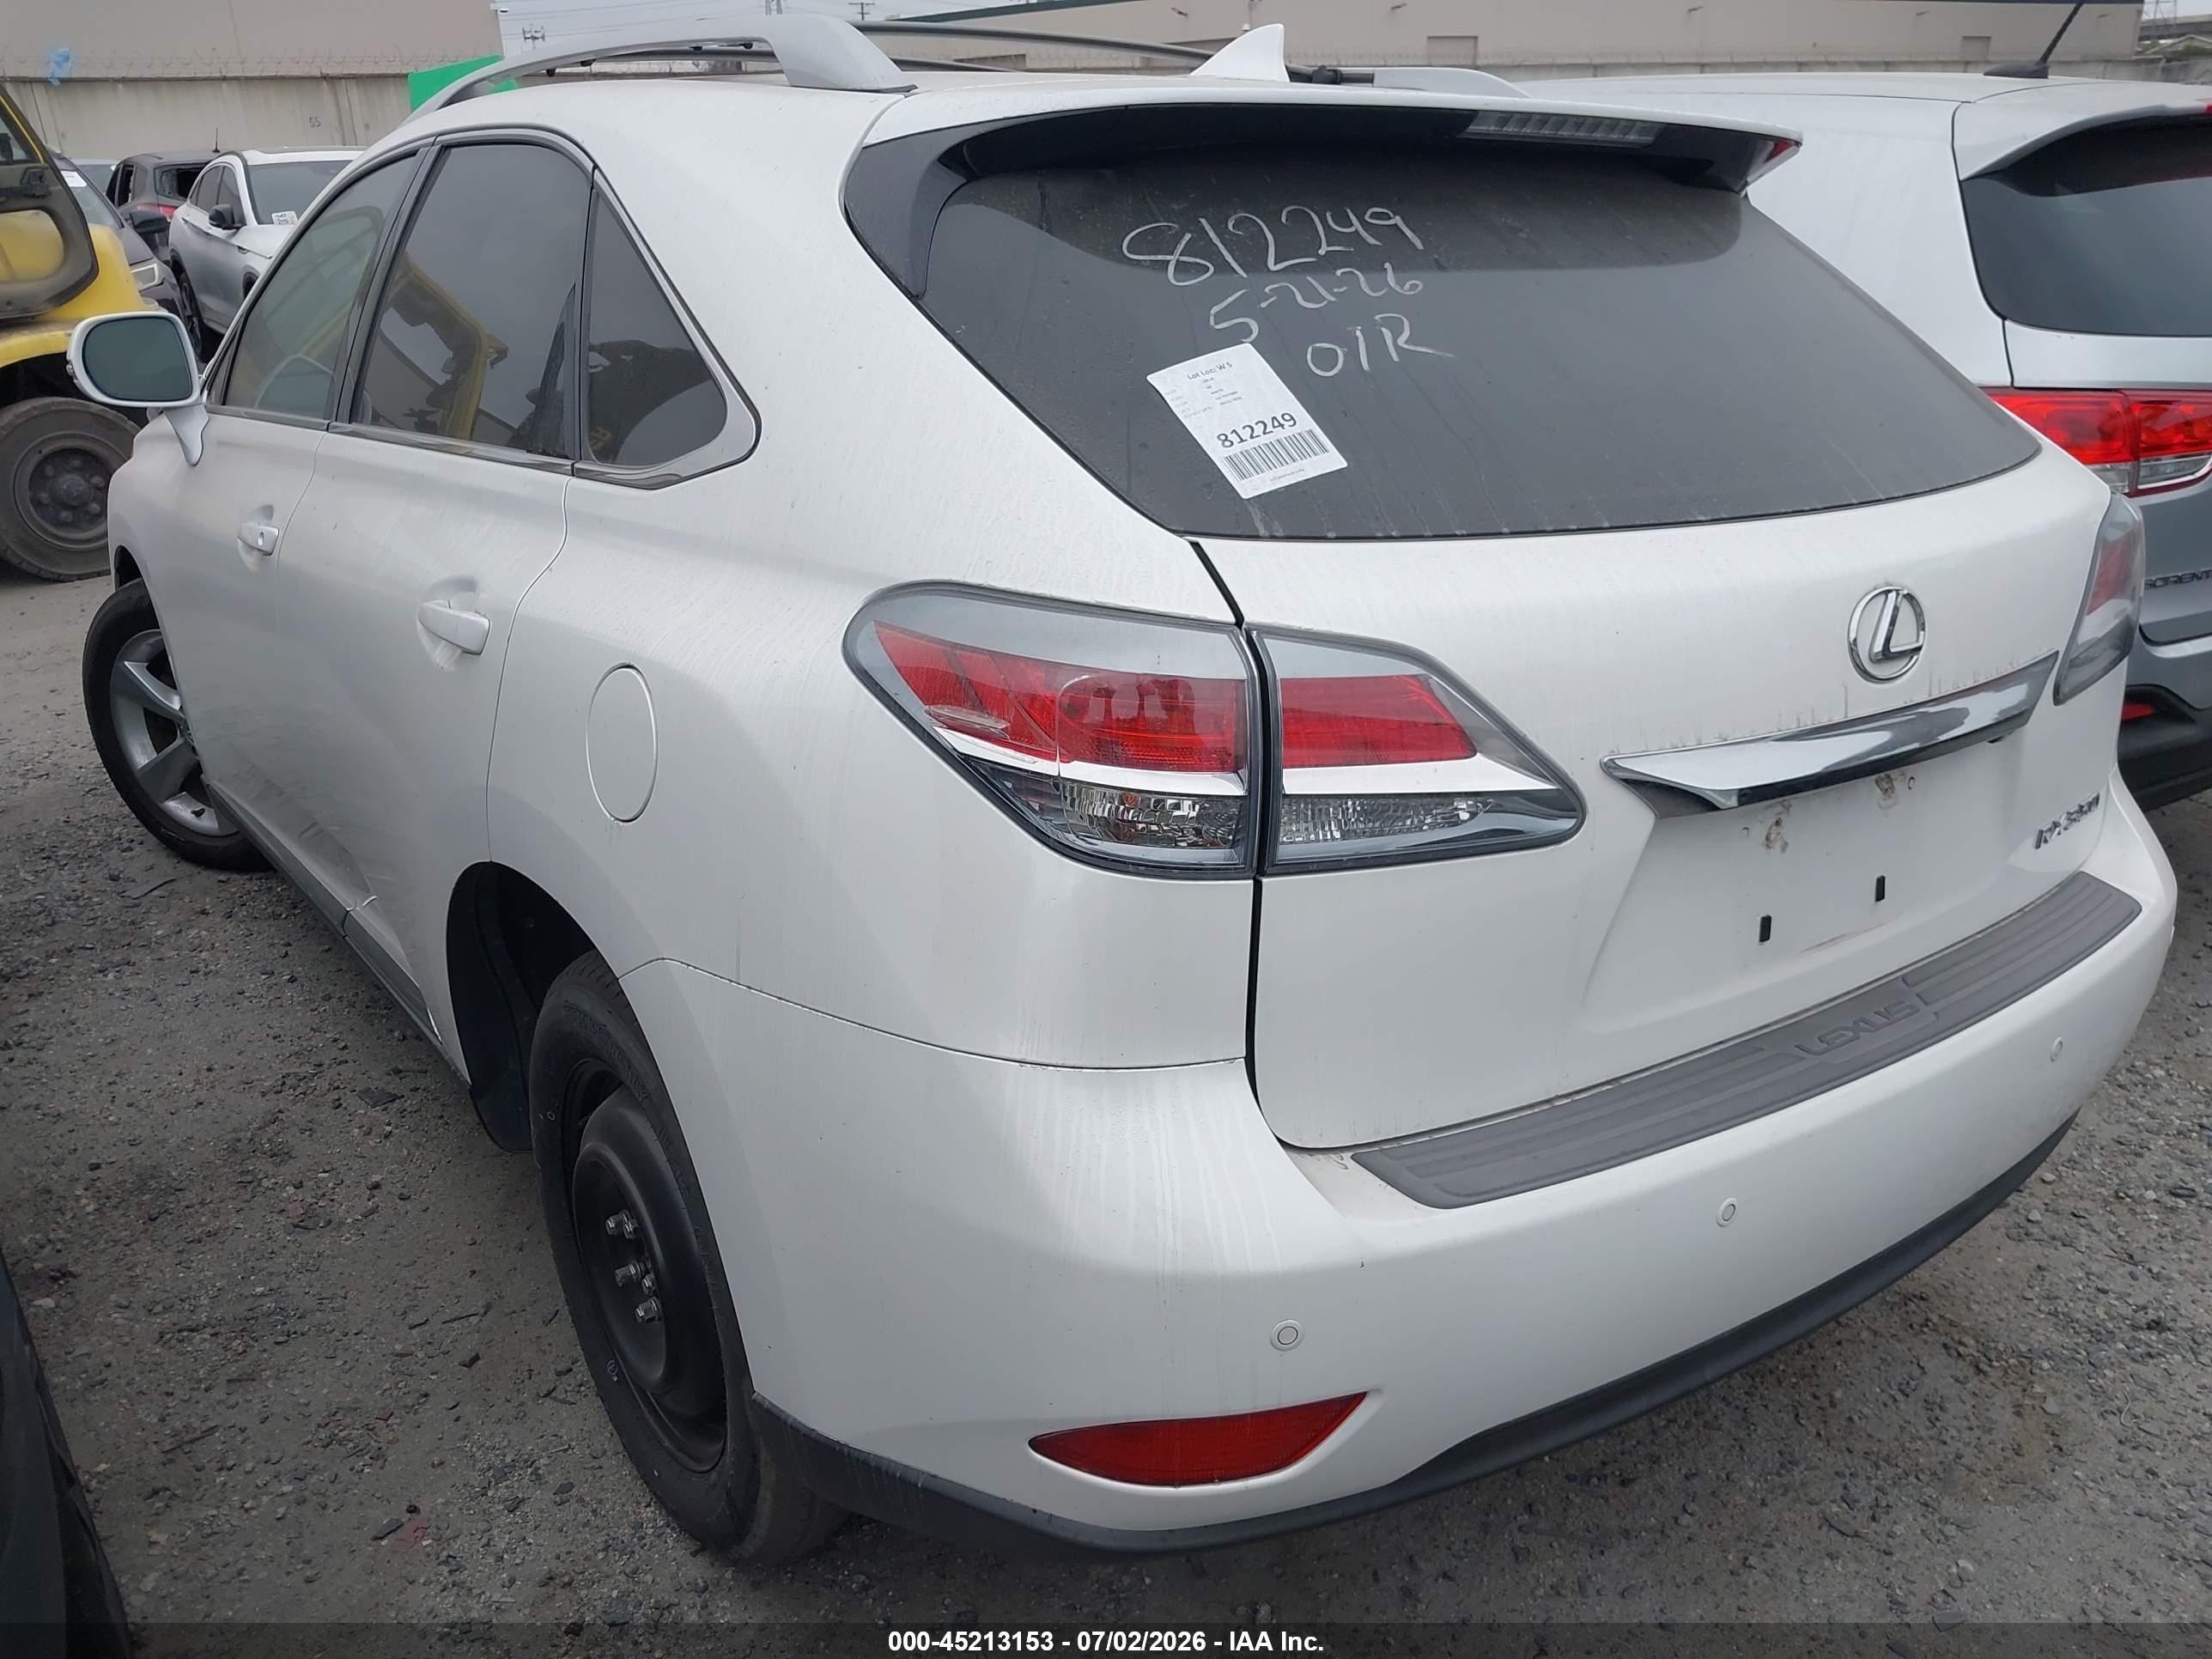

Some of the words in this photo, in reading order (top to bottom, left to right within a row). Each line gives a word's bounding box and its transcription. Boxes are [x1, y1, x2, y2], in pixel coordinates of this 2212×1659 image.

[1121, 205, 1424, 285] 812249
[1209, 262, 1424, 343] 5-21-26
[1217, 412, 1297, 448] 812249
[1794, 999, 1922, 1056] LEXUS
